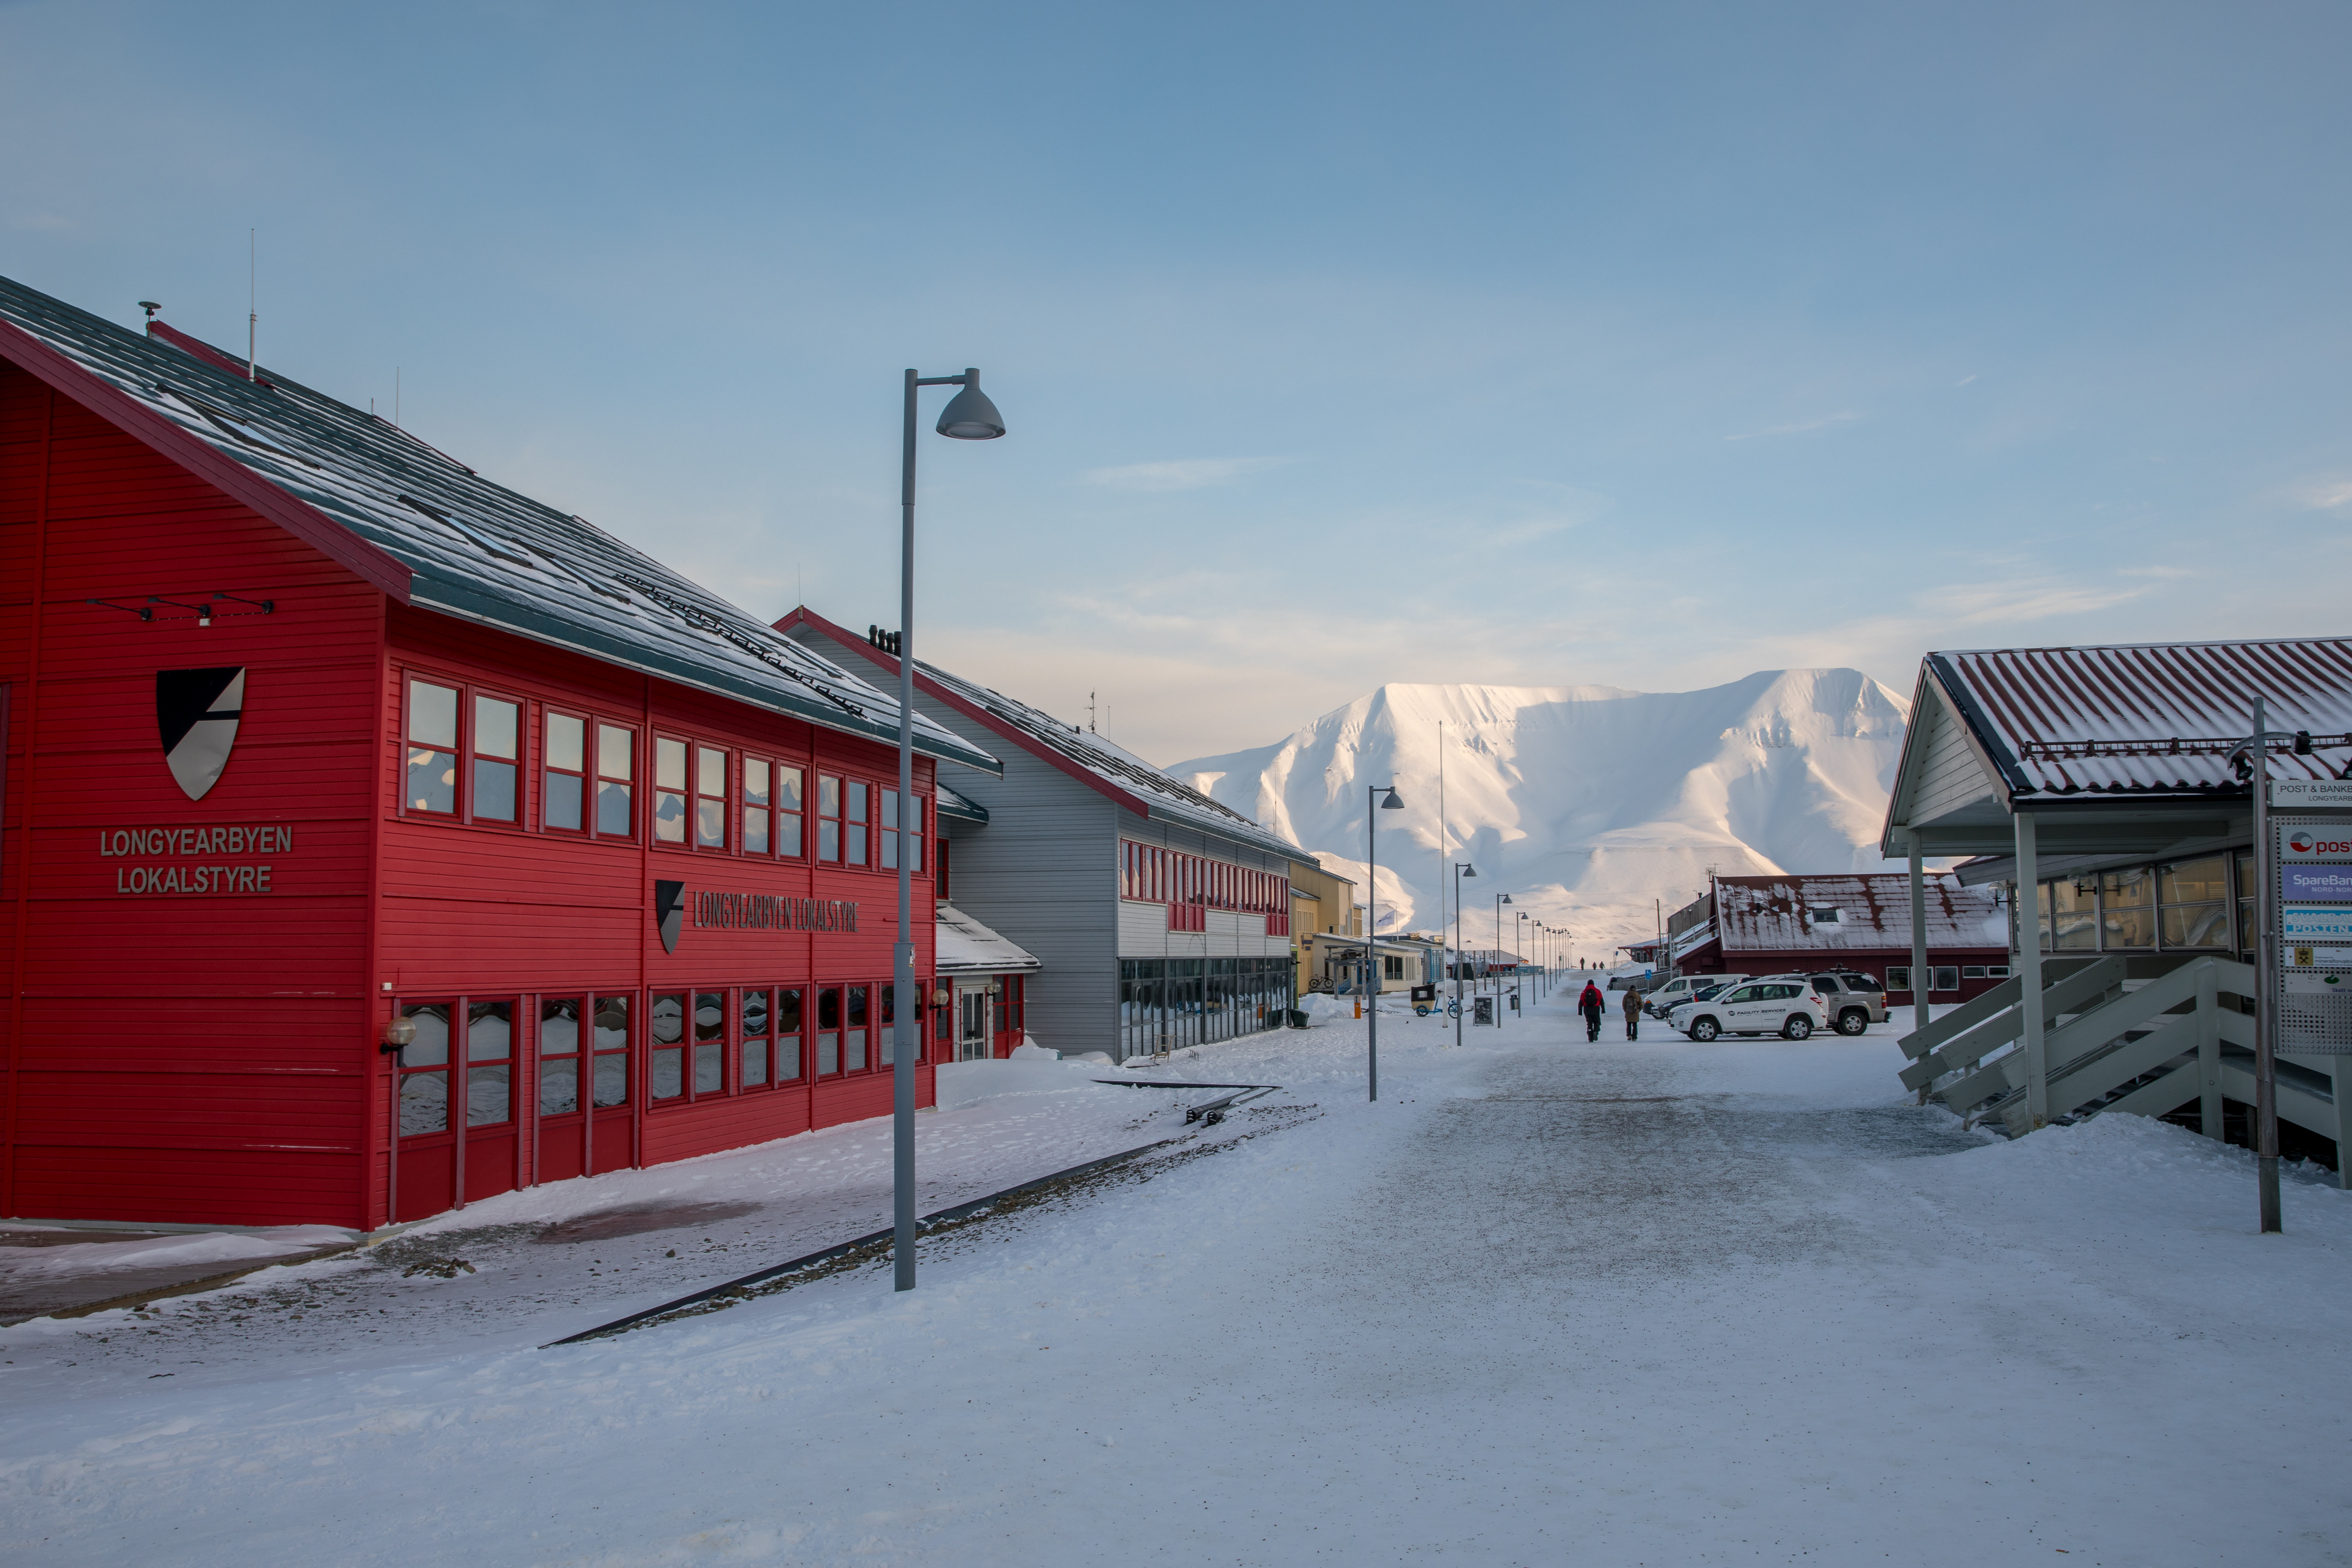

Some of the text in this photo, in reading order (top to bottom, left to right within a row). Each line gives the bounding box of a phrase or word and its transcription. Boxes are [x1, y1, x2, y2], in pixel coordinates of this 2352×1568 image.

[101, 826, 292, 856] LONGYEARBYEN
[118, 866, 271, 893] LOKALSTYRE
[2293, 875, 2352, 886] SpareBan
[695, 891, 859, 932] LONGYEARBYEN LOKALSTYRE
[2292, 924, 2349, 934] POSTEN
